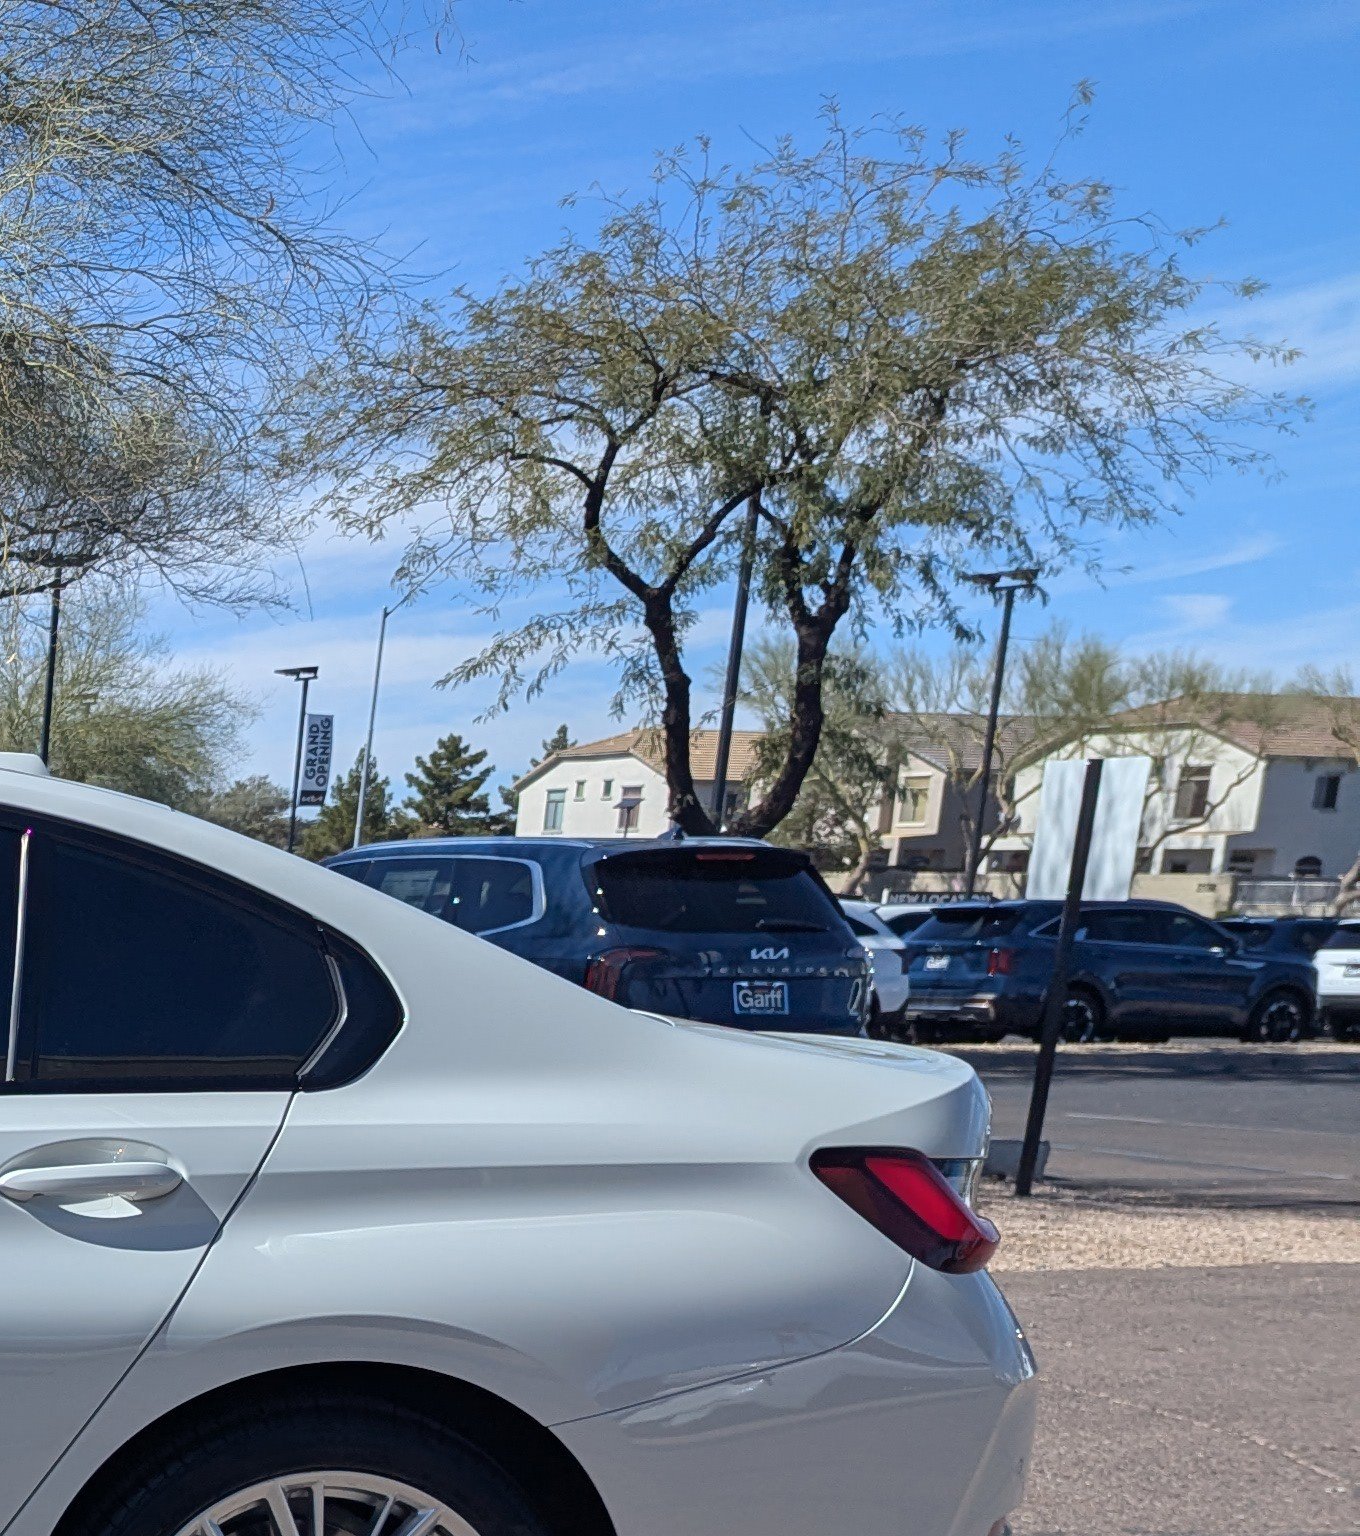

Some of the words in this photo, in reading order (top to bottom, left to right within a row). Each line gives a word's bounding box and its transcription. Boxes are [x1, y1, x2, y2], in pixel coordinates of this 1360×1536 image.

[305, 723, 319, 780] GRAND
[315, 718, 331, 787] OPENING
[750, 947, 790, 960] KIA
[738, 988, 783, 1008] Garff
